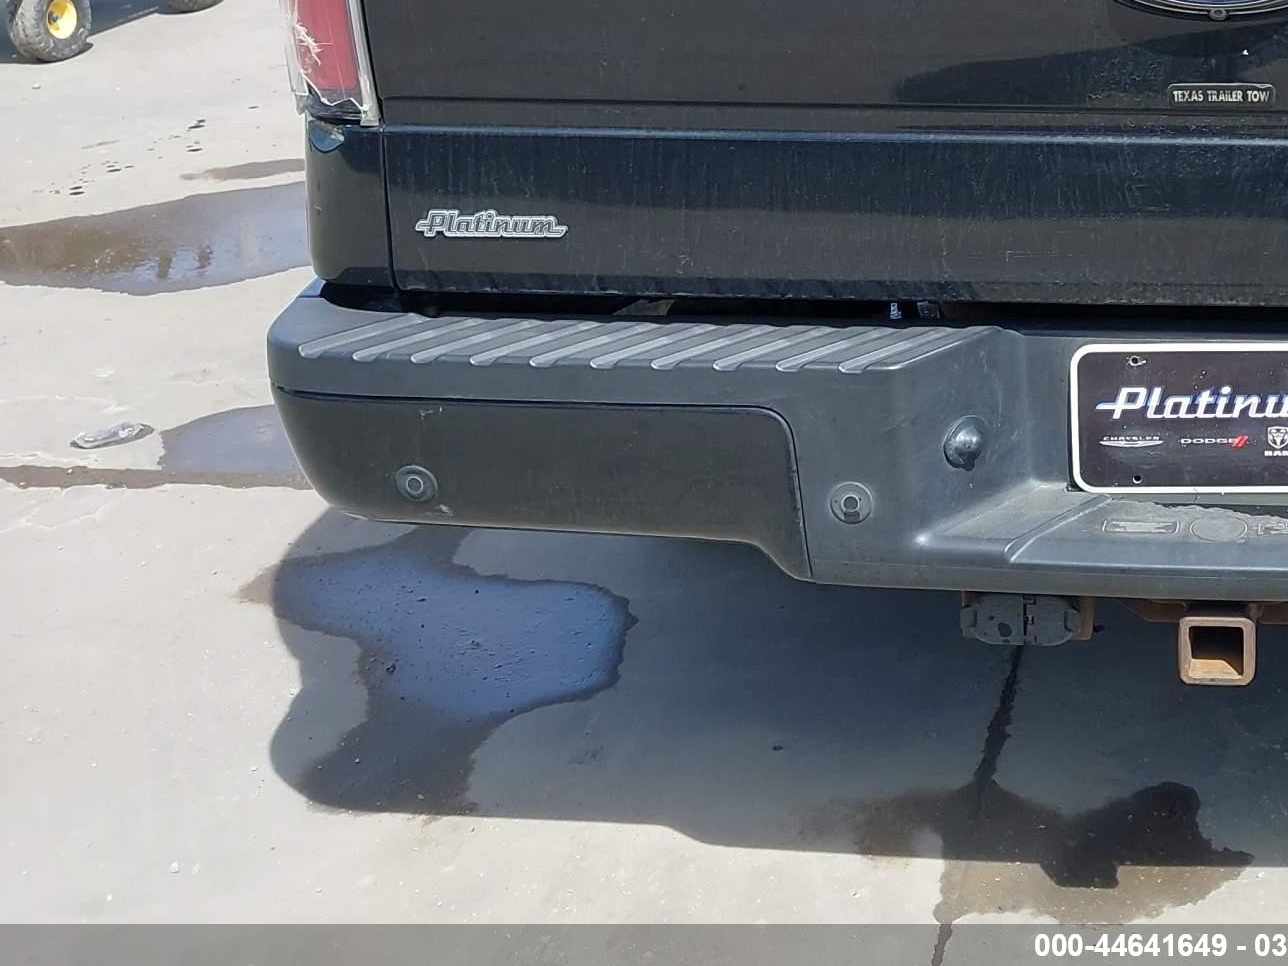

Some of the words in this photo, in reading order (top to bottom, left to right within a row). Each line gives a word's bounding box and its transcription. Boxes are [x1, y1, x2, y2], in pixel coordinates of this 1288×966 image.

[1173, 90, 1204, 102] TEXAS
[1207, 90, 1243, 102] TRAILER
[1247, 90, 1270, 102] TOW
[415, 209, 569, 238] Platinum
